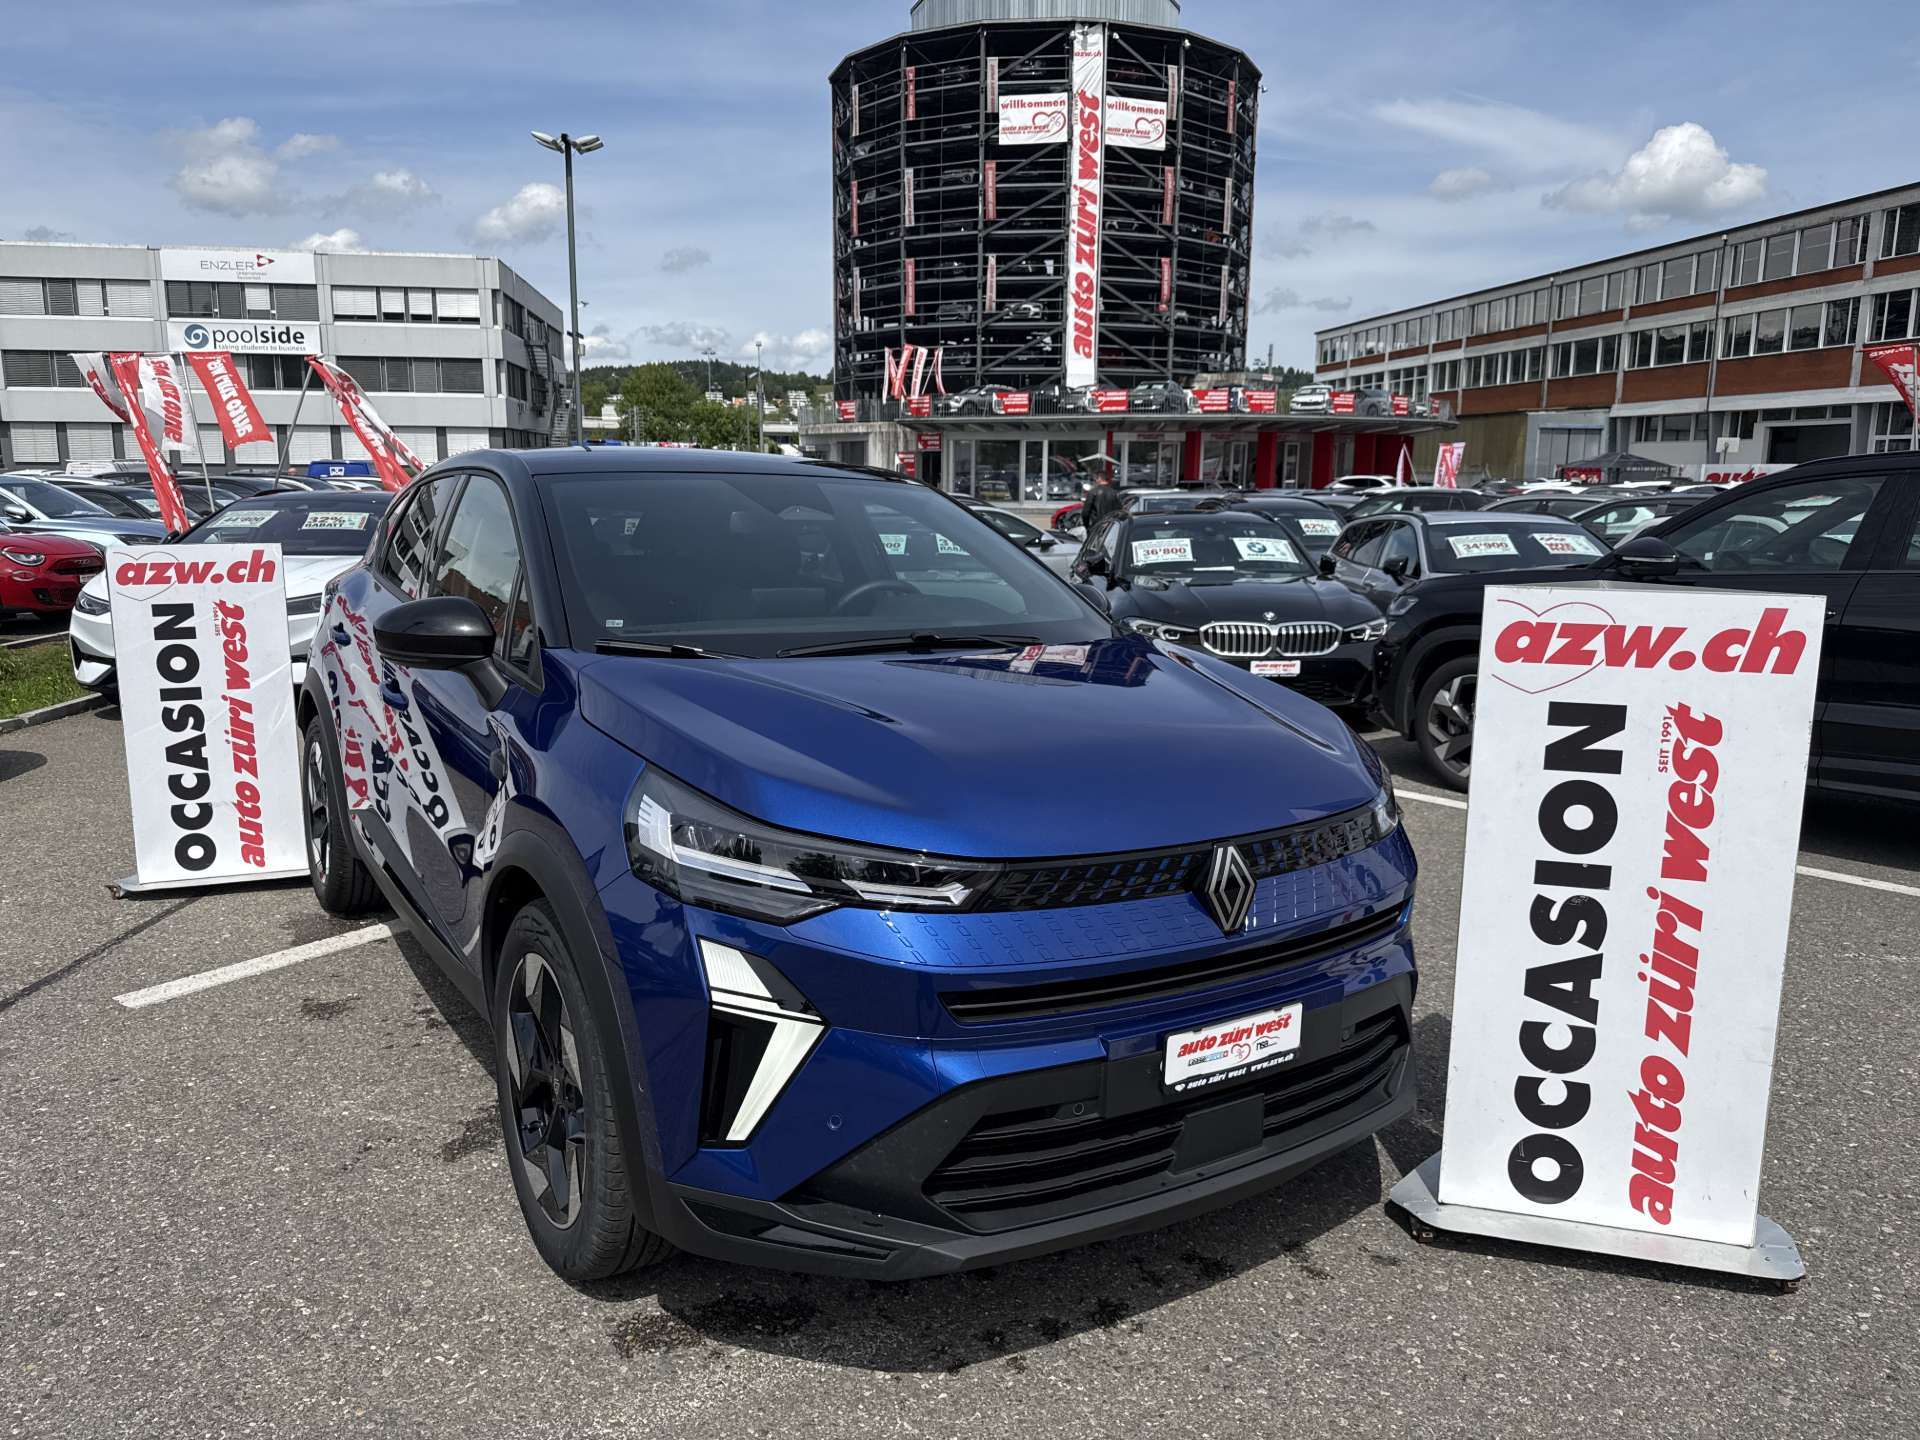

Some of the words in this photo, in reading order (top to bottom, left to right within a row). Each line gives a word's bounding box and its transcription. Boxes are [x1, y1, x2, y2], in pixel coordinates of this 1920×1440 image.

[1001, 98, 1066, 110] willkommen
[1078, 89, 1100, 180] west
[1107, 101, 1165, 115] willkommen
[200, 260, 255, 271] ENZLER
[1072, 184, 1098, 271] züri
[213, 325, 305, 349] poolside
[1072, 272, 1095, 359] auto
[116, 550, 275, 586] azw.ch
[1144, 547, 1186, 555] 36'800
[214, 599, 251, 690] west
[1494, 607, 1807, 675] azw.ch
[151, 603, 217, 871] OCCASION
[221, 693, 259, 780] züri
[1658, 748, 1669, 773] SEIT
[1661, 716, 1673, 744] 1991
[232, 781, 266, 868] auto
[1660, 701, 1723, 882] west
[1508, 701, 1627, 1204] OCCASION
[1637, 886, 1703, 1058] züri
[1177, 1034, 1217, 1058] auto
[1218, 1022, 1254, 1047] züri
[1255, 1012, 1292, 1037] west
[1187, 1078, 1207, 1089] auto
[1208, 1071, 1227, 1084] züri
[1227, 1067, 1247, 1079] west
[1627, 1055, 1686, 1225] auto
